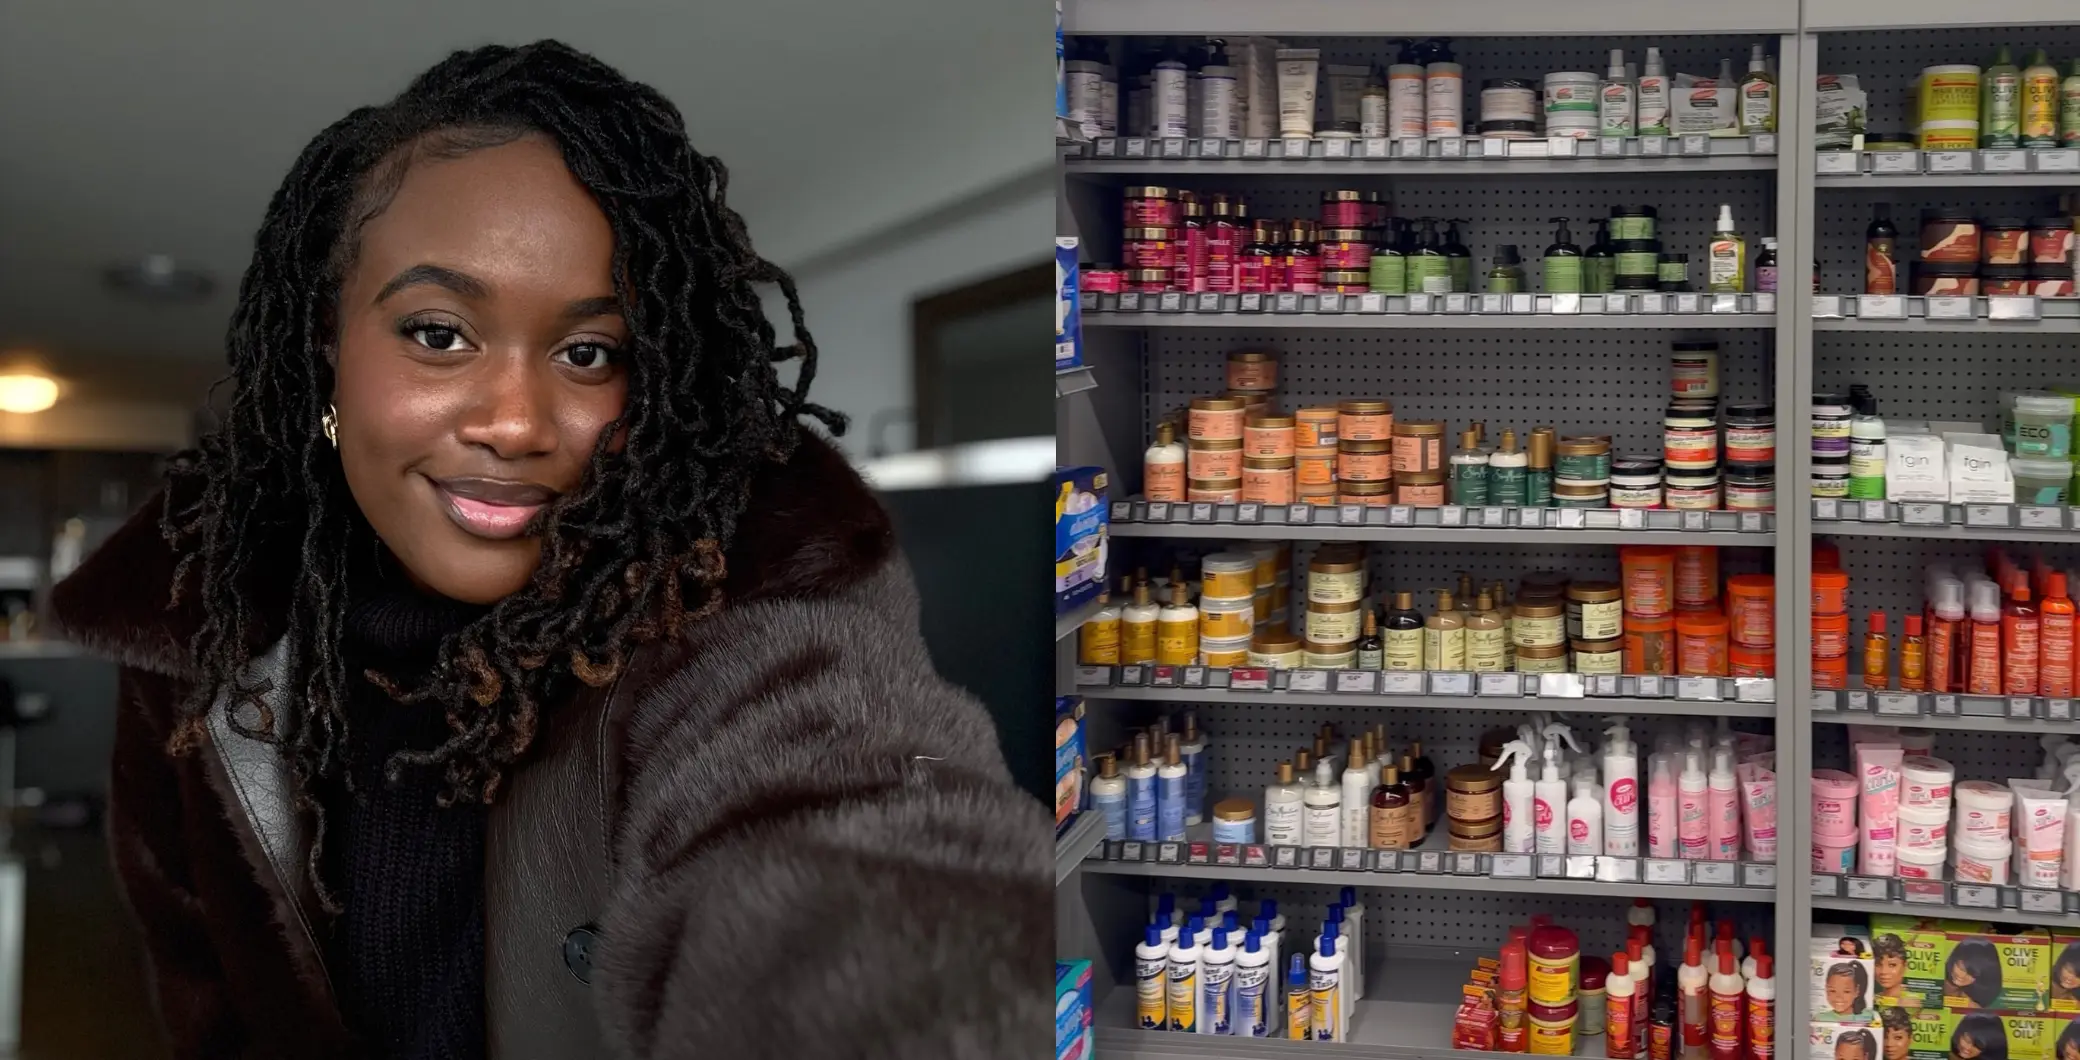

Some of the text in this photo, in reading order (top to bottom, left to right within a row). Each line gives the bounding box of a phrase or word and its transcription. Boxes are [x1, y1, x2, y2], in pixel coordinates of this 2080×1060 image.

[2019, 426, 2050, 439] ECO
[1963, 455, 1992, 472] tgin
[1905, 949, 1942, 962] OLIVE
[2003, 947, 2040, 958] OLIVE
[1907, 960, 1929, 972] OIL
[2007, 957, 2028, 967] OIL
[1911, 1022, 1947, 1034] OLIVE
[2008, 1019, 2045, 1030] OLIVE
[1912, 1032, 1934, 1044] OIL
[2012, 1029, 2033, 1039] OIL
